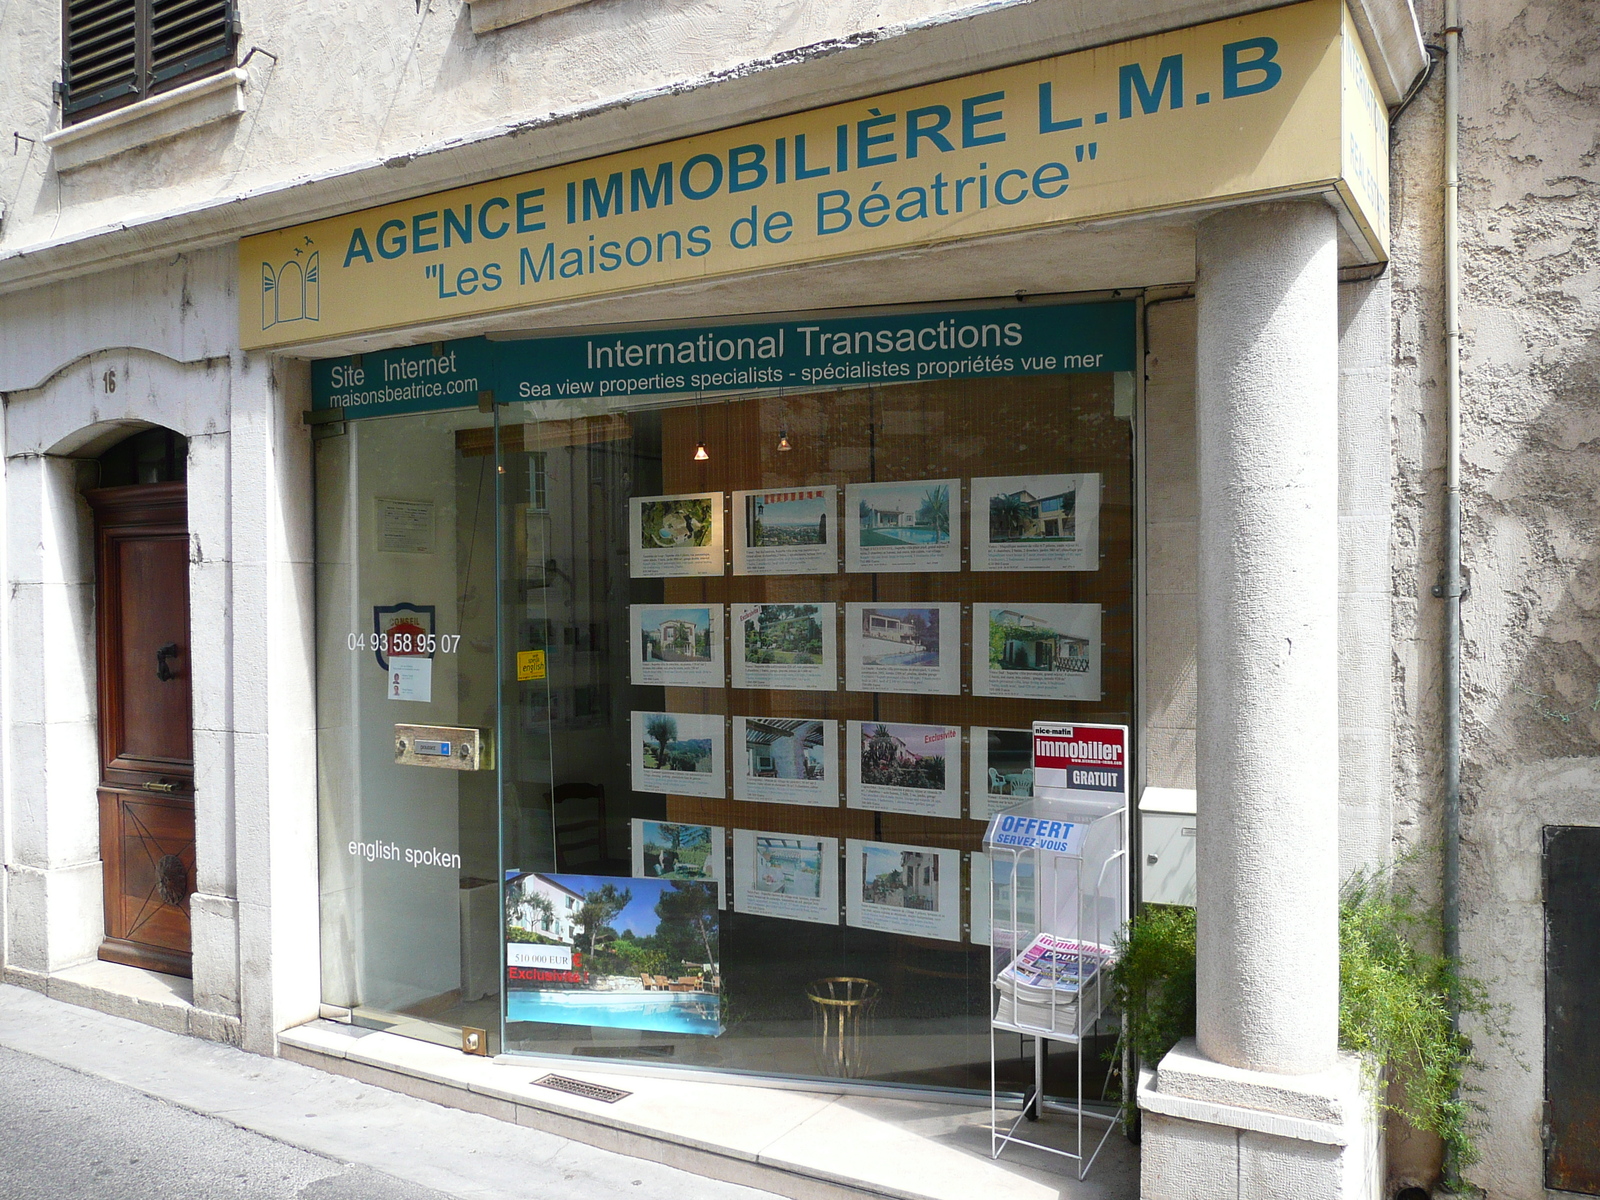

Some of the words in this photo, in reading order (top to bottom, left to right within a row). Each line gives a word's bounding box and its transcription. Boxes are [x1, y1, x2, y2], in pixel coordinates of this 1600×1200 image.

[342, 188, 546, 268] AGENCE
[567, 91, 1006, 225] IMMOBILIÈRE
[1038, 36, 1282, 135] L.M.B
[425, 262, 502, 299] "Les
[520, 224, 712, 285] Maisons
[730, 206, 793, 248] de
[817, 142, 1098, 237] Béatrice"
[587, 328, 784, 370] International
[797, 319, 1023, 357] Transactions
[331, 365, 365, 389] Site
[384, 350, 457, 382] Internet
[518, 382, 551, 399] Sea
[556, 378, 594, 395] view
[600, 373, 685, 397] properties
[690, 365, 784, 390] specialists
[801, 360, 910, 384] spécialistes
[917, 353, 1014, 379] propriétés
[1021, 356, 1057, 370] vue
[1063, 353, 1104, 369] mer
[103, 371, 116, 394] 16
[330, 377, 478, 408] maisonsbeatrice.com
[390, 617, 420, 626] CONSEIL
[347, 632, 366, 651] 04
[370, 633, 388, 652] 93
[393, 633, 412, 652] 58
[417, 634, 436, 653] 95
[441, 634, 461, 653] 07
[522, 662, 544, 673] english
[1036, 738, 1123, 761] immobilier
[1072, 770, 1118, 787] GRATUIT
[1001, 815, 1074, 840] OFFERT
[348, 839, 400, 862] english
[405, 846, 461, 869] spoken
[996, 833, 1068, 852] SERVEZ-VOUS
[515, 953, 530, 962] 510
[532, 954, 547, 963] 000
[549, 955, 568, 965] EUR
[509, 966, 581, 983] Exclusivité
